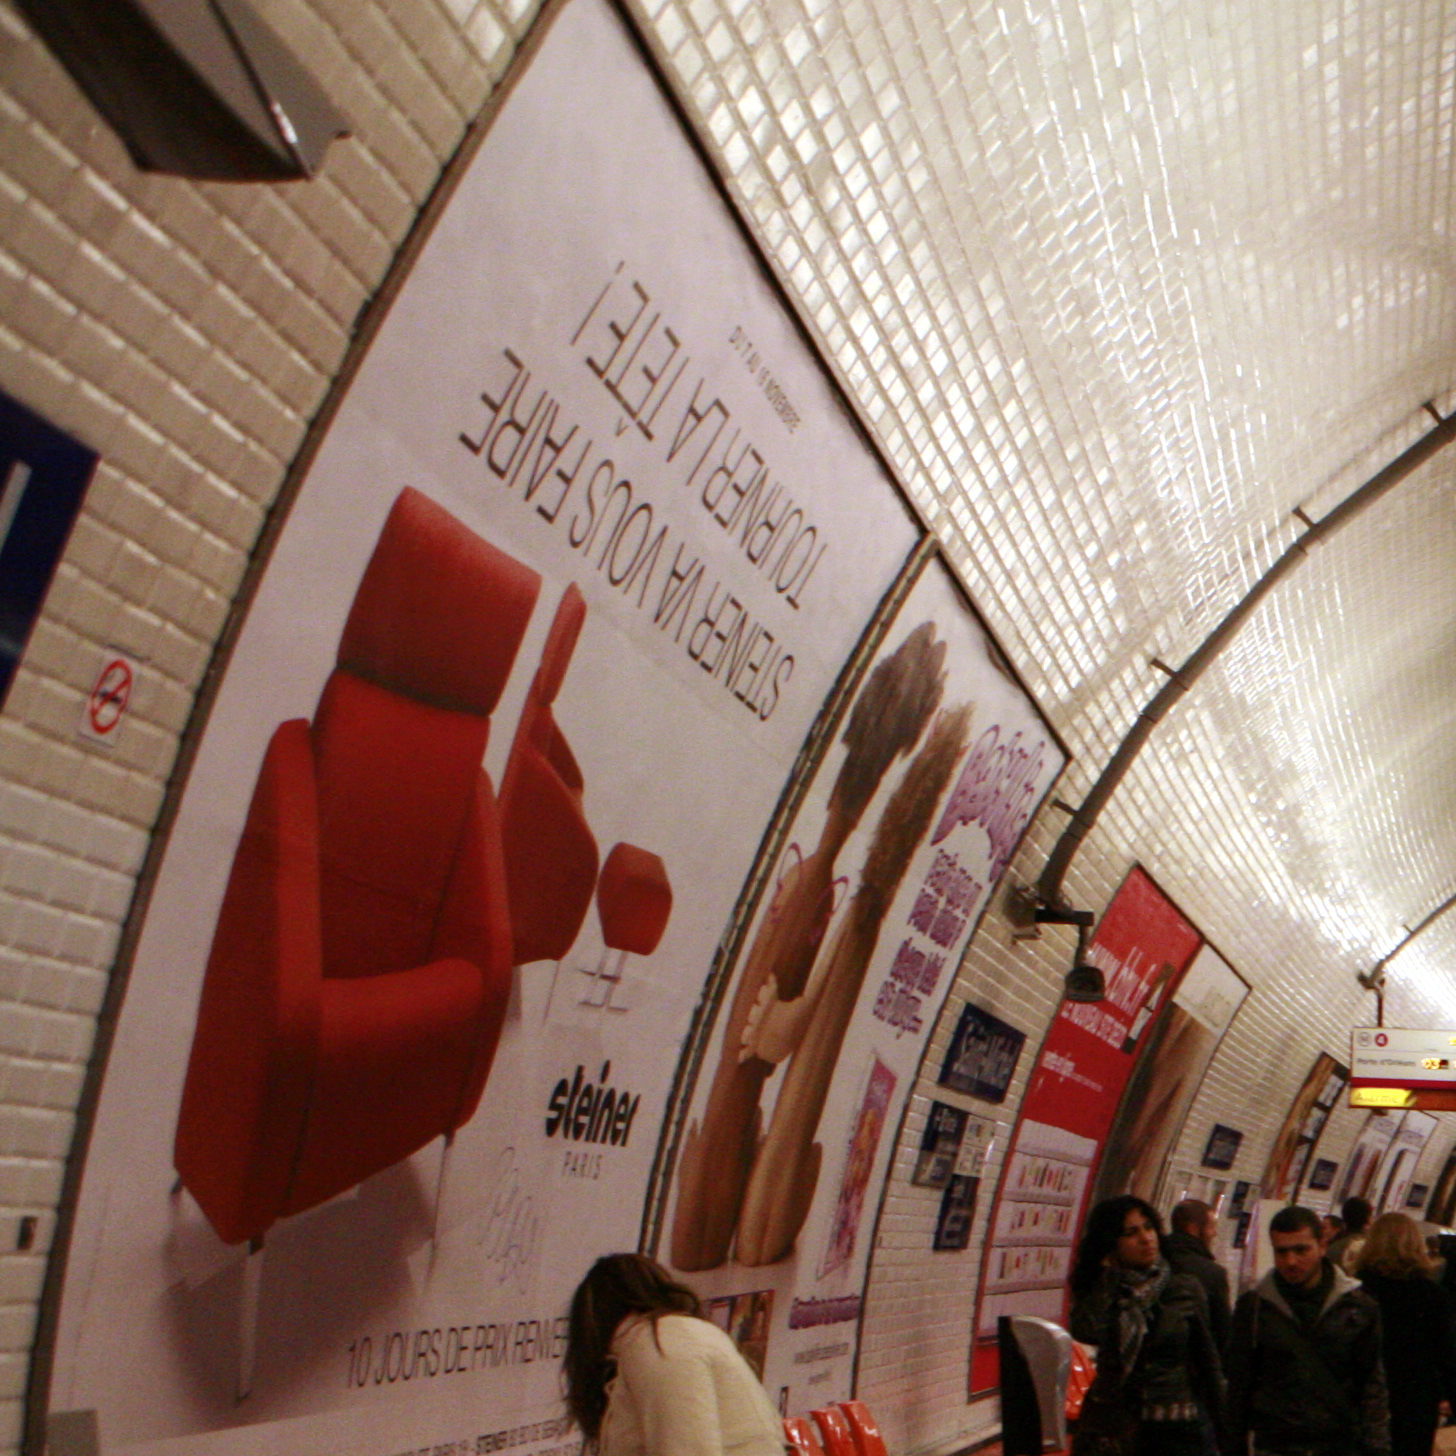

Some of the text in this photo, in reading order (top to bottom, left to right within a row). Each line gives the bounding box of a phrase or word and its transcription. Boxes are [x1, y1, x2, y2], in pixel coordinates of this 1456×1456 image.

[666, 377, 731, 487] LA
[458, 348, 795, 722] STEINER VA VOUS FAIRE
[701, 428, 828, 610] TOURNER
[545, 1059, 642, 1148] steiner
[347, 1316, 571, 1389] 10 JOURS DE PRIX RENVE
